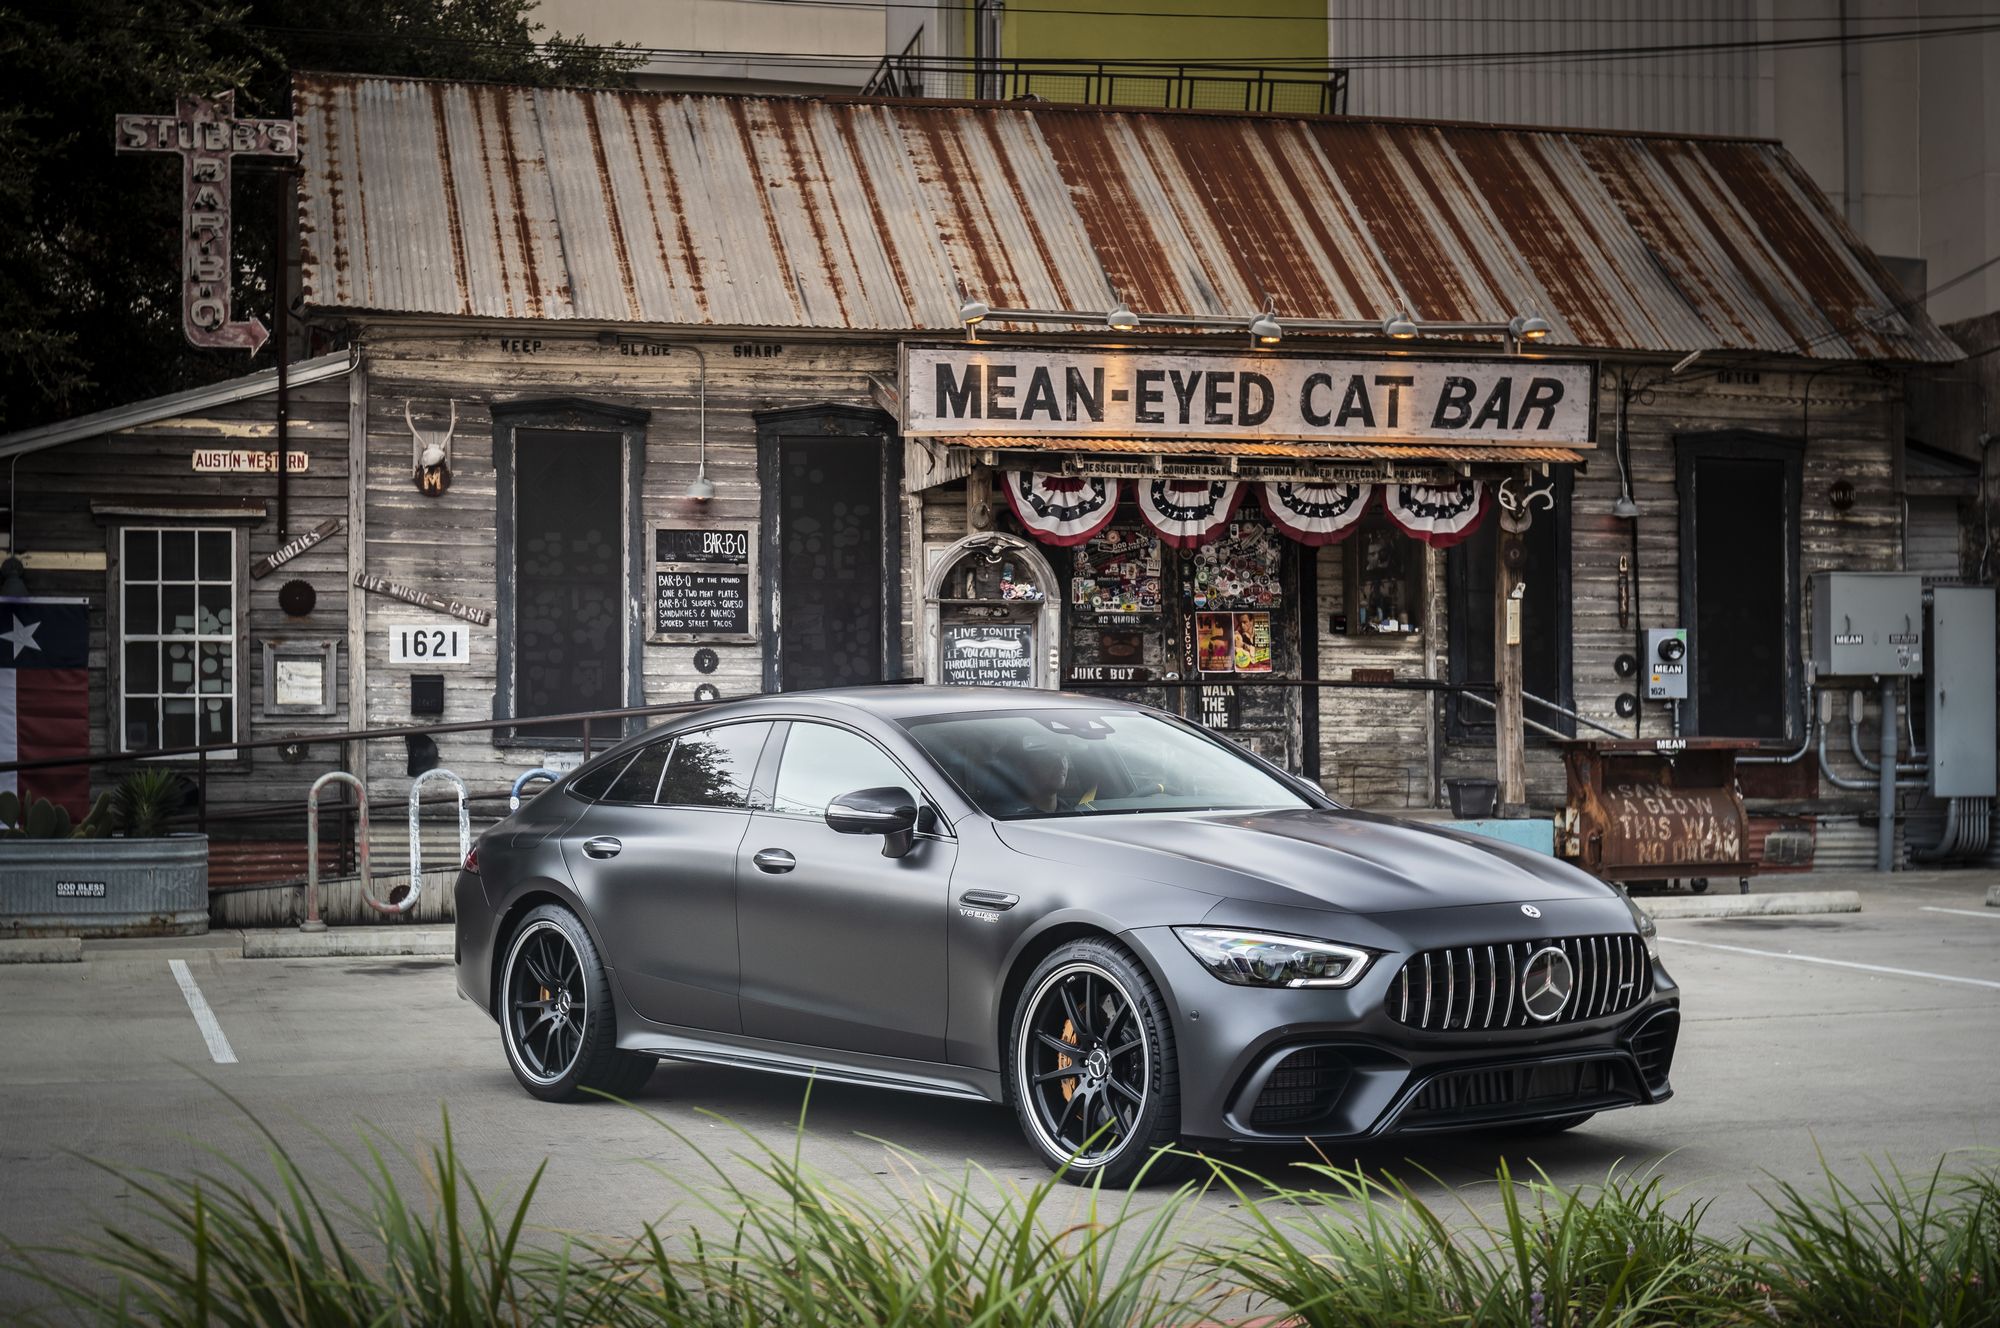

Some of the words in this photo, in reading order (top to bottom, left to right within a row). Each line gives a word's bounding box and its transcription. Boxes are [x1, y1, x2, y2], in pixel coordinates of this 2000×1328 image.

[122, 117, 292, 152] STUBB'S
[501, 340, 542, 353] KEEP
[620, 343, 671, 356] BLADE
[733, 344, 783, 358] SHARP
[935, 362, 1275, 427] MEAN-EYED
[1300, 373, 1414, 428] CAT
[1431, 375, 1566, 431] BAR
[195, 452, 306, 469] AUSTIN-WESTRN
[1119, 464, 1138, 474] LIKE
[1163, 465, 1201, 475] CORONER
[1334, 467, 1393, 479] PENTECOSTA
[423, 471, 442, 490] M
[267, 530, 321, 568] KOOZIES
[703, 532, 747, 555] BAR-B-Q
[355, 573, 386, 592] LIVE
[390, 583, 430, 605] MUSIC
[450, 601, 487, 624] CASH
[662, 589, 674, 597] ONE
[685, 589, 697, 597] TWO
[718, 590, 739, 598] PLATES
[691, 599, 716, 607] SLIDERS
[660, 609, 697, 618] SANDWICHES
[711, 609, 736, 618] NACHOS
[660, 620, 684, 628] SMOKED
[954, 627, 978, 639] LIVE
[981, 627, 1021, 640] TONITE
[1836, 635, 1862, 644] MEAN
[402, 630, 458, 657] 1621
[962, 648, 979, 658] YOU
[980, 648, 996, 658] CAN
[998, 648, 1024, 659] WADE
[945, 658, 978, 670] THROUGH
[1655, 664, 1682, 674] MEAN
[951, 669, 977, 681] YOU'LL
[978, 669, 1000, 680] FIND
[1002, 669, 1017, 679] ME
[1071, 667, 1102, 680] JUKE
[1202, 685, 1235, 696] WALK
[1651, 688, 1666, 696] 1621
[1201, 697, 1225, 712] THE
[1202, 713, 1229, 728] LINE
[1656, 739, 1686, 750] MEAN
[1624, 799, 1639, 814] A
[1643, 797, 1713, 815] GLOW
[1619, 815, 1672, 840] THIS
[1636, 841, 1665, 863] NO
[1673, 839, 1740, 863] DREAM
